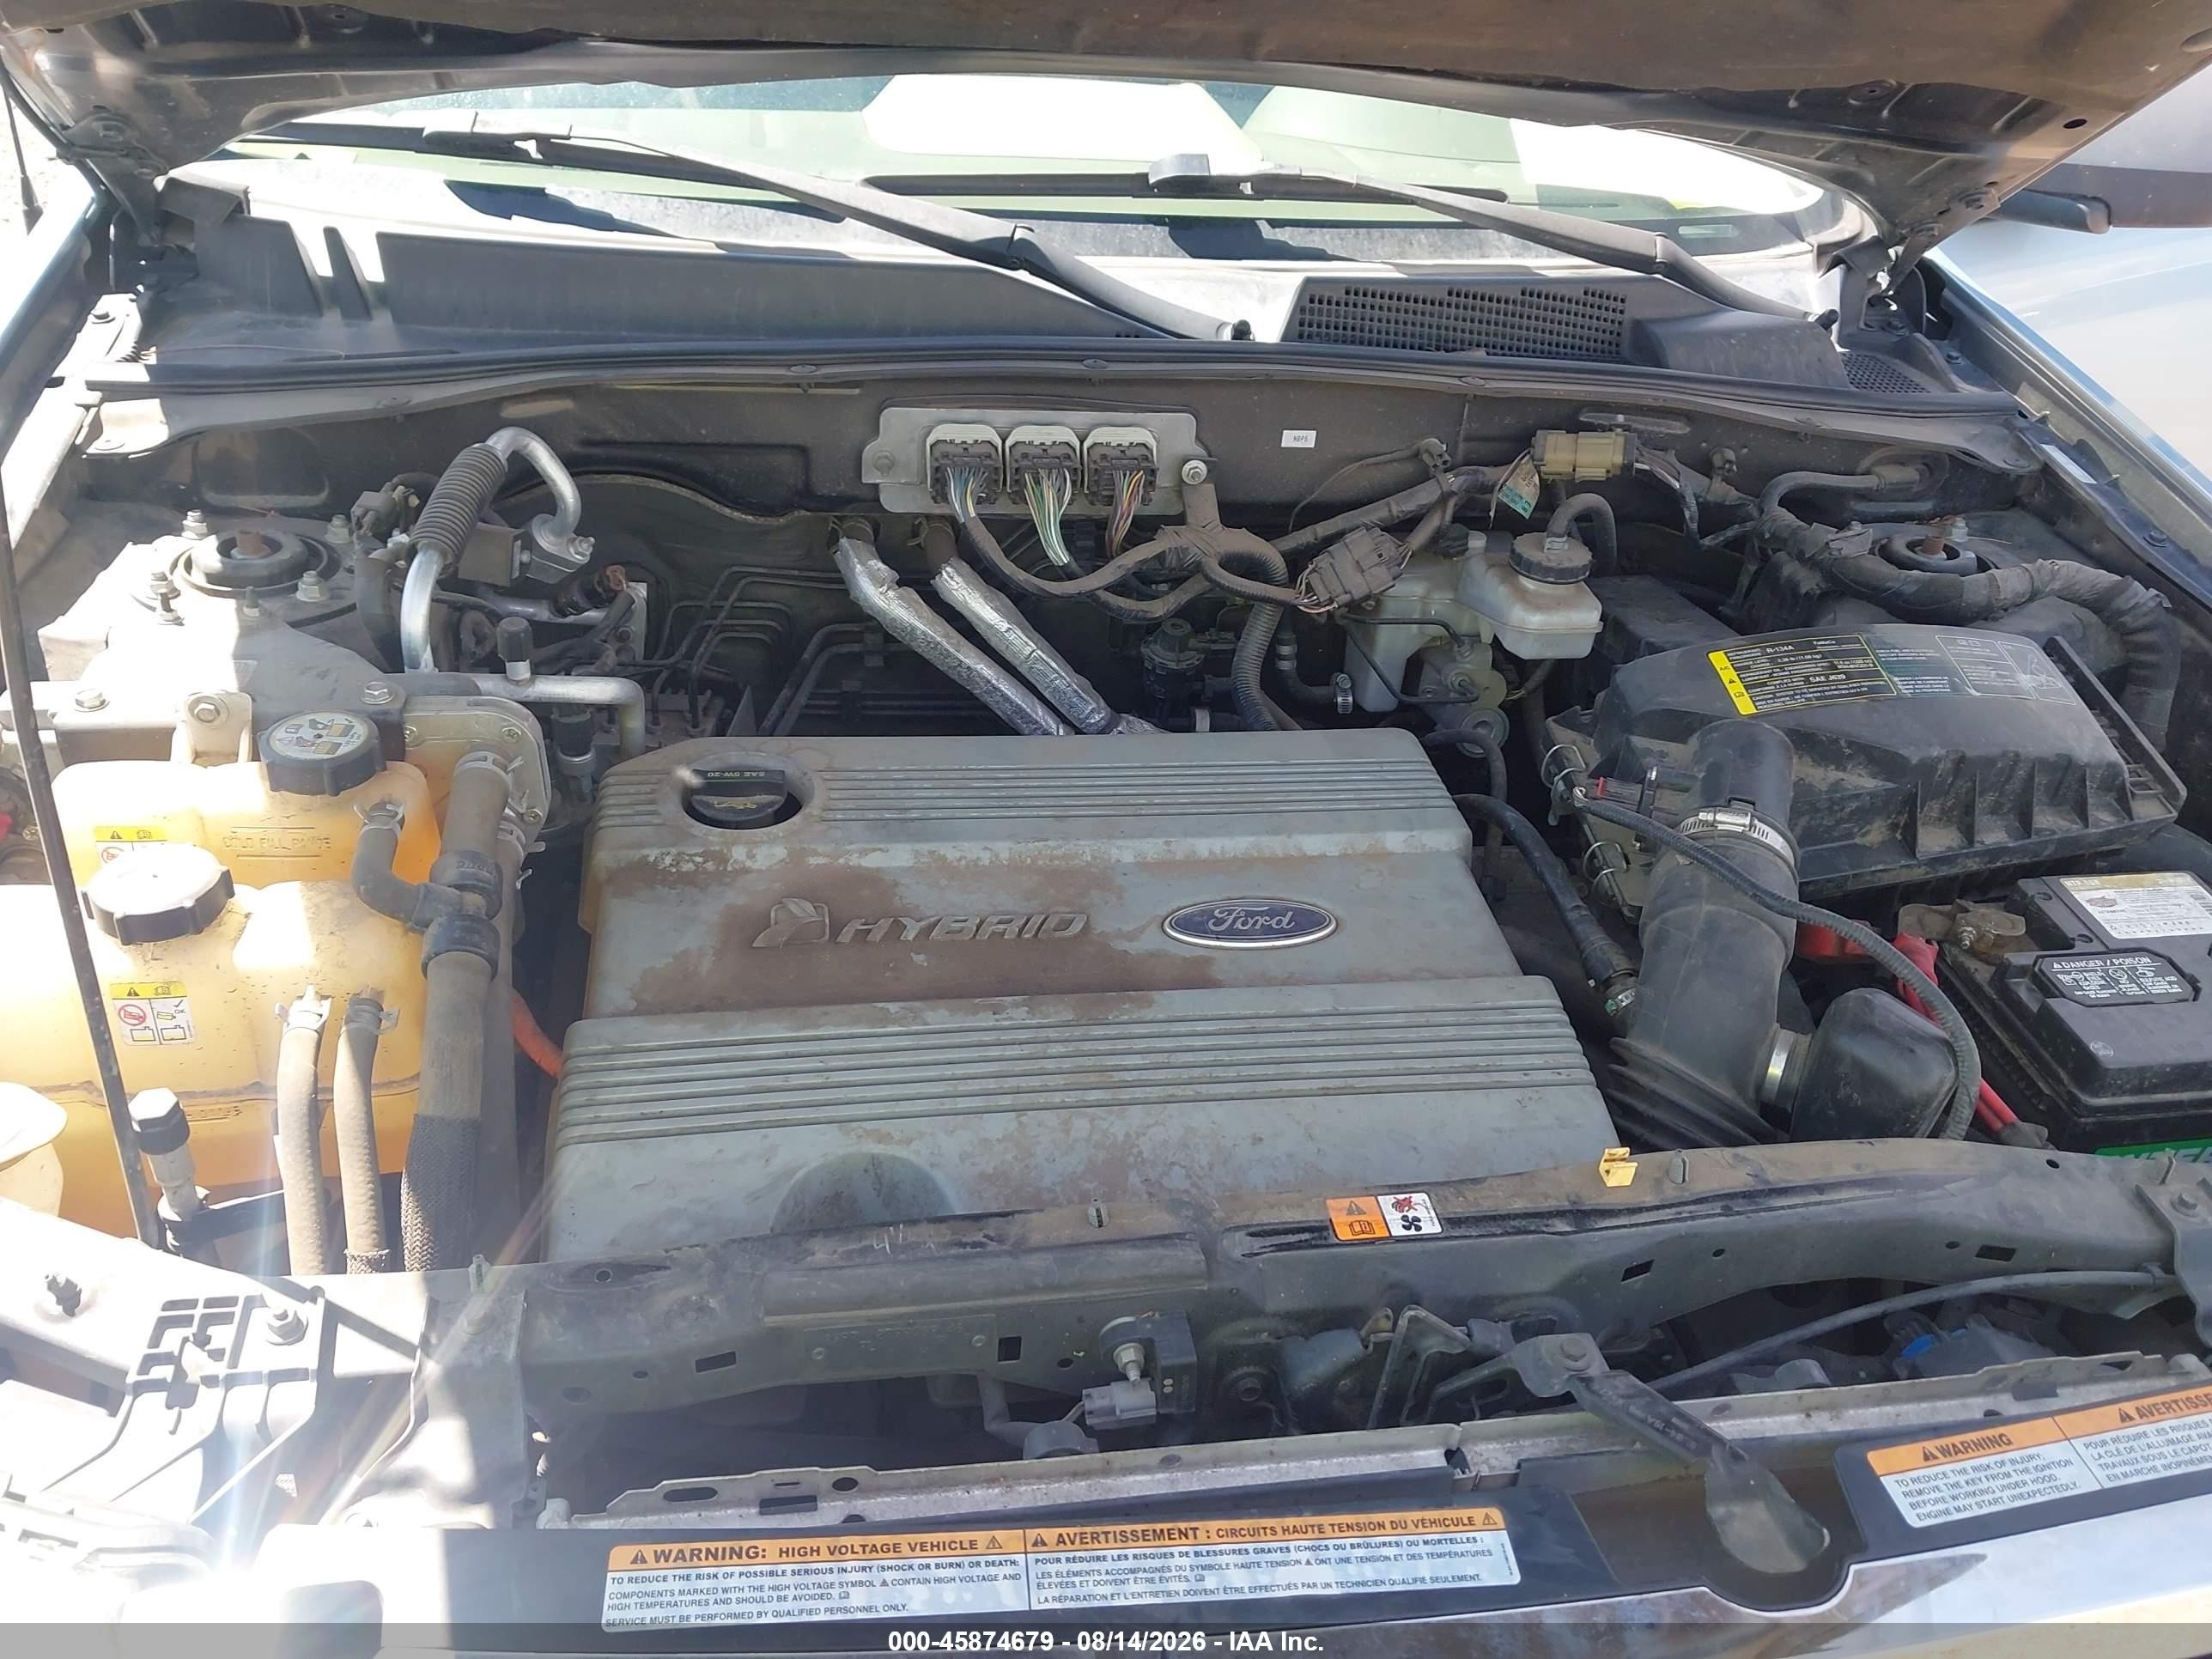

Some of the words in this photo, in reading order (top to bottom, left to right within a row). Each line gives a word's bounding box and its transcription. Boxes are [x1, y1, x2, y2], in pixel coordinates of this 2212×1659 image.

[836, 913, 1087, 943] HYBRID
[1208, 906, 1295, 931] Ford
[2061, 959, 2104, 969] DANGER
[2114, 957, 2152, 966] POISON
[1936, 1433, 2013, 1458] WARNING
[2083, 1438, 2109, 1450] POUR
[2112, 1431, 2149, 1445] RÉDUIRE
[2150, 1427, 2169, 1437] LES
[2169, 1419, 2209, 1433] RISQUES
[2091, 1452, 2103, 1461] LA
[2104, 1447, 2124, 1459] CLÉ
[2124, 1445, 2137, 1455] DE
[2138, 1434, 2194, 1451] L'ALLUMAGE
[2098, 1457, 2141, 1471] TRAVAUX
[2143, 1452, 2167, 1463] SOUS
[2168, 1448, 2180, 1458] LE
[2180, 1443, 2211, 1455] CAPOT
[1894, 1479, 1909, 1488] TO
[1910, 1471, 1949, 1486] REDUCE
[1951, 1468, 1970, 1479] THE
[1972, 1462, 1994, 1474] RISK
[1994, 1460, 2007, 1469] OF
[1902, 1486, 1942, 1499] REMOVE
[1944, 1481, 1963, 1492] THE
[1966, 1477, 1984, 1488] KEY
[1986, 1471, 2013, 1484] FROM
[2013, 1467, 2033, 1477] THE
[2033, 1459, 2074, 1474] IGNITION
[2106, 1473, 2120, 1482] EN
[2120, 1464, 2160, 1479] MARCHE
[1910, 1496, 1948, 1510] BEFORE
[1949, 1486, 1996, 1503] WORKING
[1996, 1480, 2030, 1494] UNDER
[2030, 1474, 2061, 1486] HOOD.
[1916, 1509, 1953, 1522] ENGINE
[1954, 1503, 1974, 1514] MAY
[1976, 1497, 2006, 1510] START
[2007, 1481, 2081, 1504] UNEXPECTEDLY.
[1055, 1527, 1200, 1546] AVERTISSEMENT
[1216, 1526, 1278, 1539] CIRCUITS
[1281, 1523, 1326, 1535] HAUTE
[1331, 1521, 1386, 1534] TENSION
[1391, 1519, 1408, 1529] DU
[1413, 1516, 1476, 1528] VÉHICULE
[653, 1545, 767, 1563] WARNING:
[779, 1547, 821, 1558] HIGH
[826, 1543, 902, 1556] VOLTAGE
[908, 1540, 978, 1552] VEHICLE
[1035, 1557, 1062, 1565] POUR
[1066, 1554, 1108, 1564] RÉDUIRE
[1111, 1553, 1129, 1562] LES
[1133, 1551, 1175, 1561] RISQUES
[1178, 1550, 1191, 1559] DE
[1194, 1547, 1249, 1558] BLESSURES
[1253, 1545, 1291, 1555] GRAVES
[1294, 1543, 1330, 1553] (CHOCS
[1422, 1536, 1478, 1546] MORTELLES
[1055, 1568, 1102, 1578] ÉLÉMENTS
[1105, 1564, 1172, 1576] ACCOMPAGNÉS
[1175, 1564, 1187, 1572] DU
[1189, 1561, 1231, 1572] SYMBOLE
[1234, 1560, 1262, 1570] HAUTE
[1265, 1559, 1303, 1568] TENSION
[1334, 1556, 1352, 1565] UNE
[1354, 1554, 1392, 1564] TENSION
[1394, 1553, 1404, 1562] ET
[1407, 1553, 1424, 1561] DES
[1426, 1549, 1493, 1560] TEMPÉRATURES
[611, 1577, 624, 1585] TO
[628, 1575, 668, 1584] REDUCE
[672, 1573, 692, 1582] THE
[695, 1572, 719, 1581] RISK
[722, 1571, 735, 1580] OF
[738, 1569, 787, 1579] POSSIBLE
[791, 1567, 834, 1577] SERIOUS
[838, 1565, 873, 1574] INJURY
[877, 1563, 915, 1573] (SHOCK
[934, 1560, 965, 1570] BURN)
[985, 1559, 1019, 1568] DEATH:
[1079, 1579, 1090, 1588] ET
[1093, 1577, 1131, 1587] DOIVENT
[609, 1589, 675, 1600] COMPONENTS
[678, 1588, 718, 1597] MARKED
[721, 1586, 744, 1595] WITH
[768, 1583, 791, 1592] HIGH
[793, 1582, 836, 1591] VOLTAGE
[838, 1580, 877, 1589] SYMBOL
[891, 1577, 931, 1587] CONTAIN
[933, 1577, 957, 1585] HIGH
[959, 1574, 1000, 1583] VOLTAGE
[1002, 1573, 1022, 1582] AND
[1052, 1594, 1108, 1603] RÉPARATION
[1123, 1589, 1180, 1601] L'ENTRETIEN
[1183, 1588, 1220, 1597] DOIVENT
[1249, 1582, 1299, 1594] EFFECTUÉS
[1334, 1578, 1387, 1589] TECHNICIEN
[1430, 1574, 1482, 1584] SEULEMENT.
[605, 1616, 647, 1626] SERVICE
[650, 1615, 676, 1624] MUST
[695, 1611, 754, 1622] PERFORMED
[772, 1607, 821, 1618] QUALIFIED
[823, 1606, 880, 1614] PERSONNEL
[883, 1603, 908, 1613] ONLY.
[634, 1599, 709, 1610] TEMPERATURES
[735, 1595, 774, 1605] SHOULD
[792, 1593, 836, 1602] AVOIDED.
